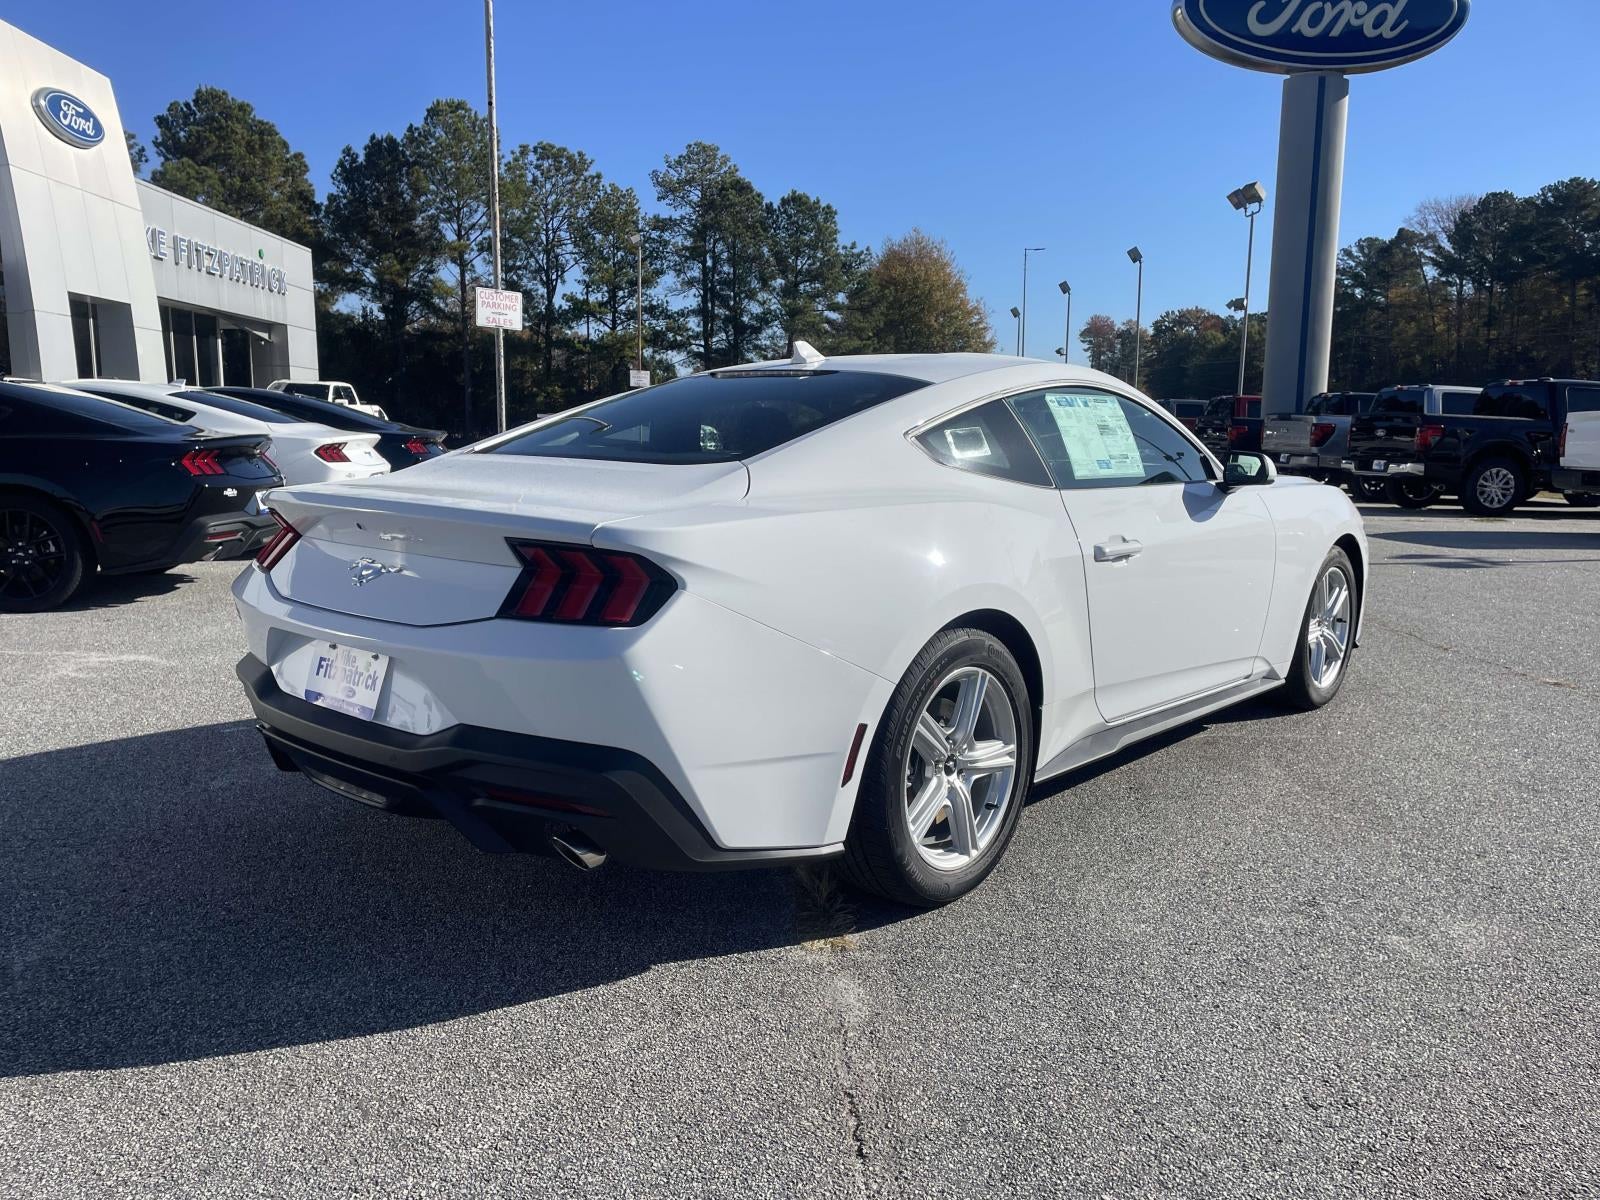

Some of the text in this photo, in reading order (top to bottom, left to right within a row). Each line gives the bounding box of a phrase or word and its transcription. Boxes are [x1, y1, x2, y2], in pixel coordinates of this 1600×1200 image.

[60, 99, 95, 136] Ford
[173, 233, 288, 296] FITZPATRICK
[479, 290, 519, 304] CUSTOMER
[481, 300, 517, 312] PARKING
[486, 316, 513, 326] SALES
[329, 646, 357, 668] ike
